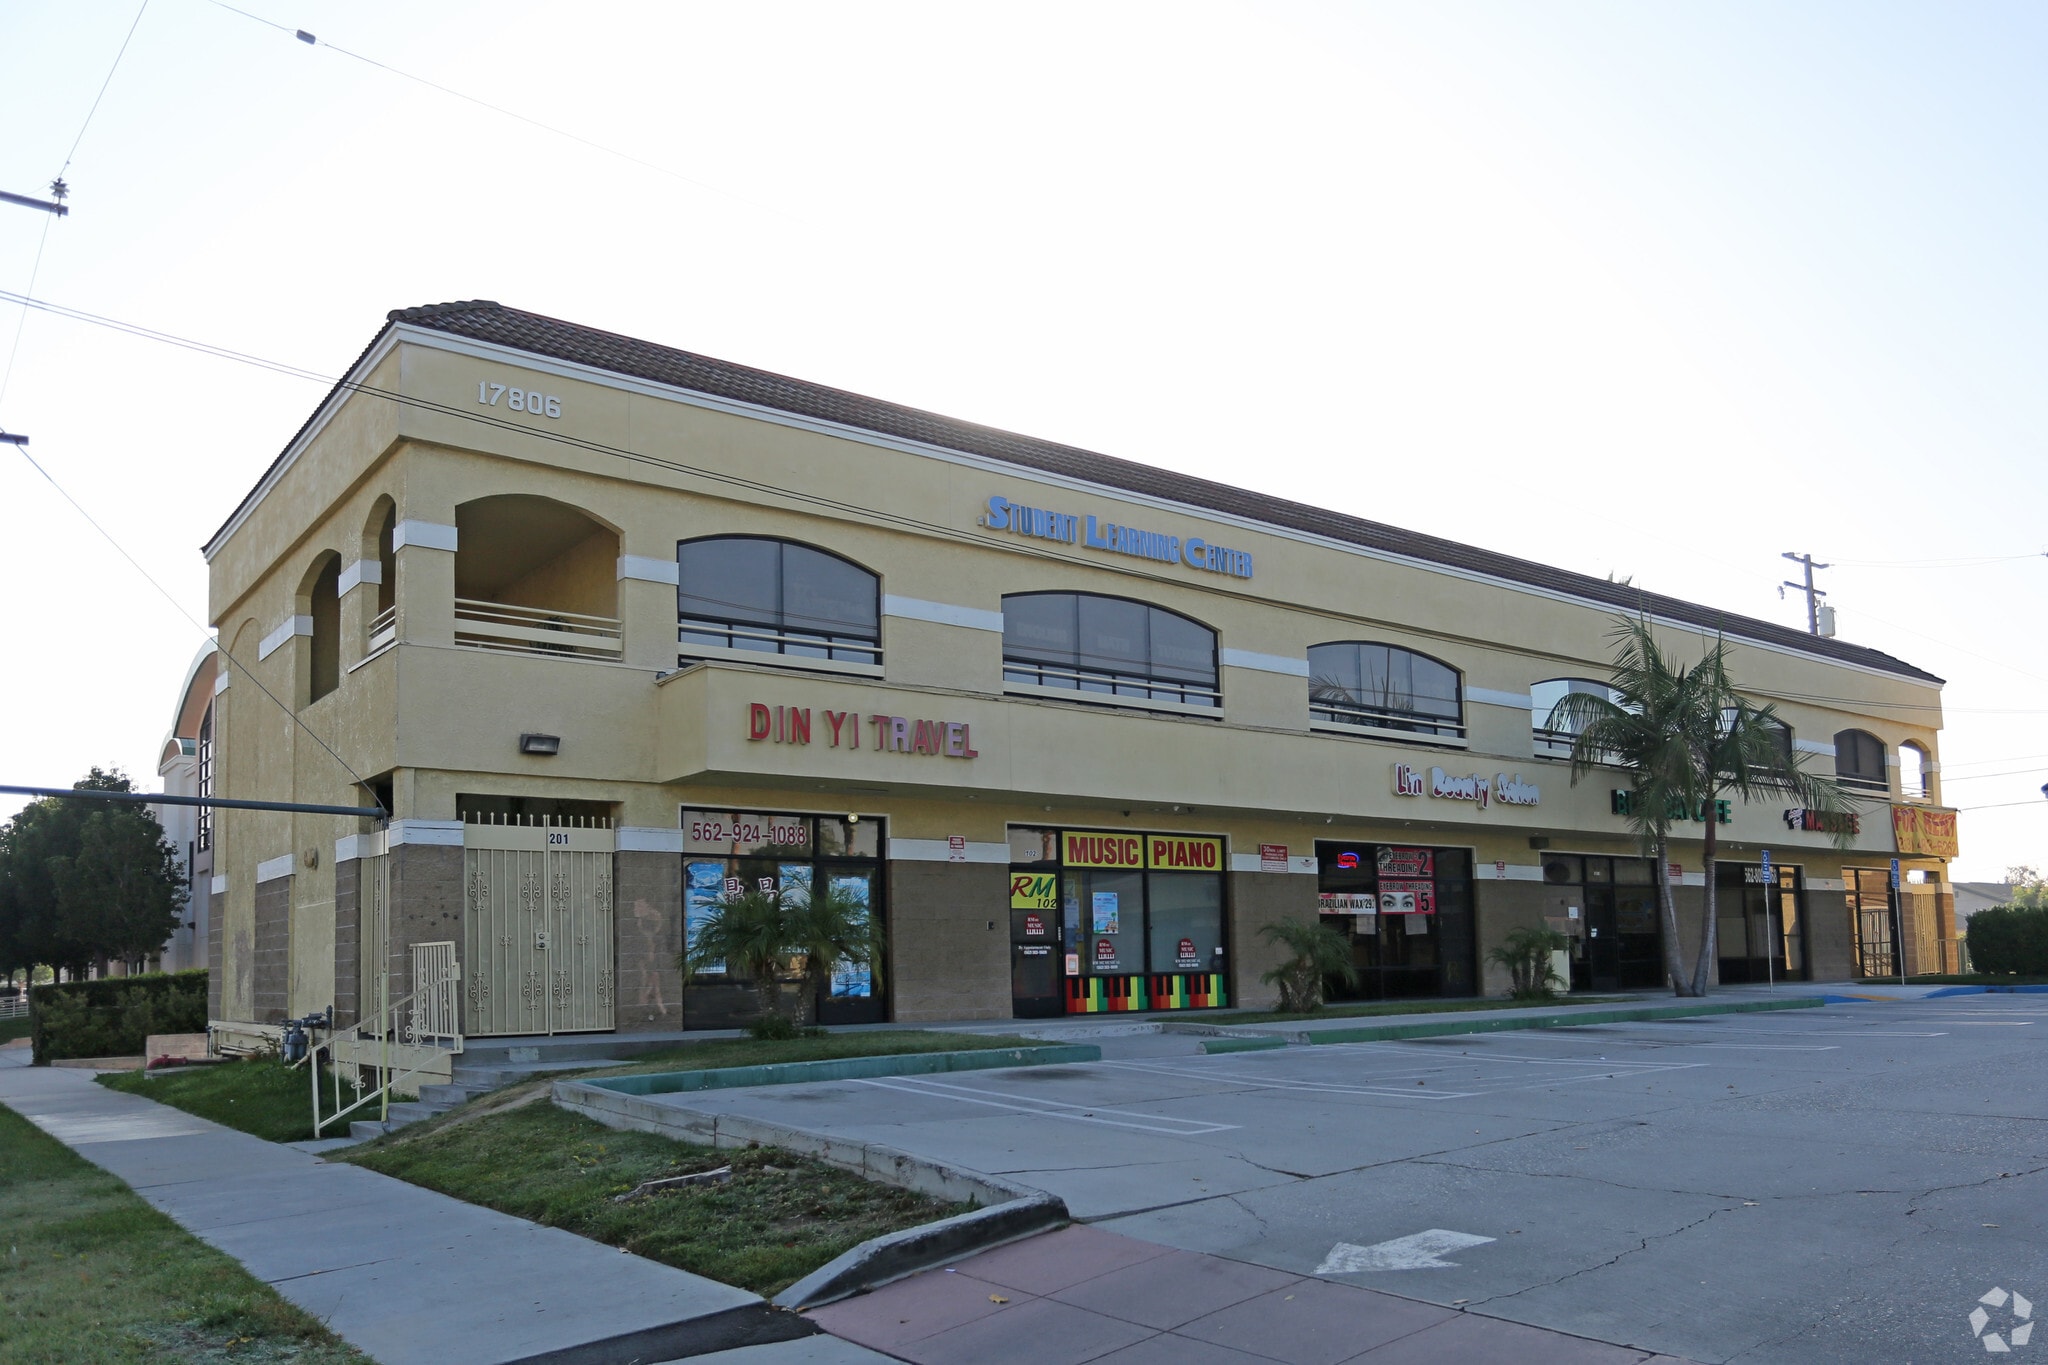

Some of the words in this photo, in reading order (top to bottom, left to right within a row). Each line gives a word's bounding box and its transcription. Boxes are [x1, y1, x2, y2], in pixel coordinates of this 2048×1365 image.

[478, 381, 561, 419] 17806
[748, 702, 812, 745] DIN
[825, 709, 860, 749] YI
[869, 714, 979, 758] TRAVEL
[1393, 762, 1423, 796] Lin
[1893, 807, 1917, 832] FOR
[1922, 811, 1955, 837] RENT
[549, 833, 569, 845] 201
[692, 822, 807, 845] 562-924-1088
[1068, 836, 1139, 866] MUSIC
[1153, 840, 1216, 868] PIANO
[1389, 851, 1414, 860] EYEBROW
[1378, 862, 1417, 873] THREADING
[1010, 876, 1054, 898] RM
[1379, 882, 1404, 890] EYEBROW
[1405, 882, 1433, 891] THREADING
[1037, 898, 1057, 909] 102
[1350, 899, 1363, 909] WAX
